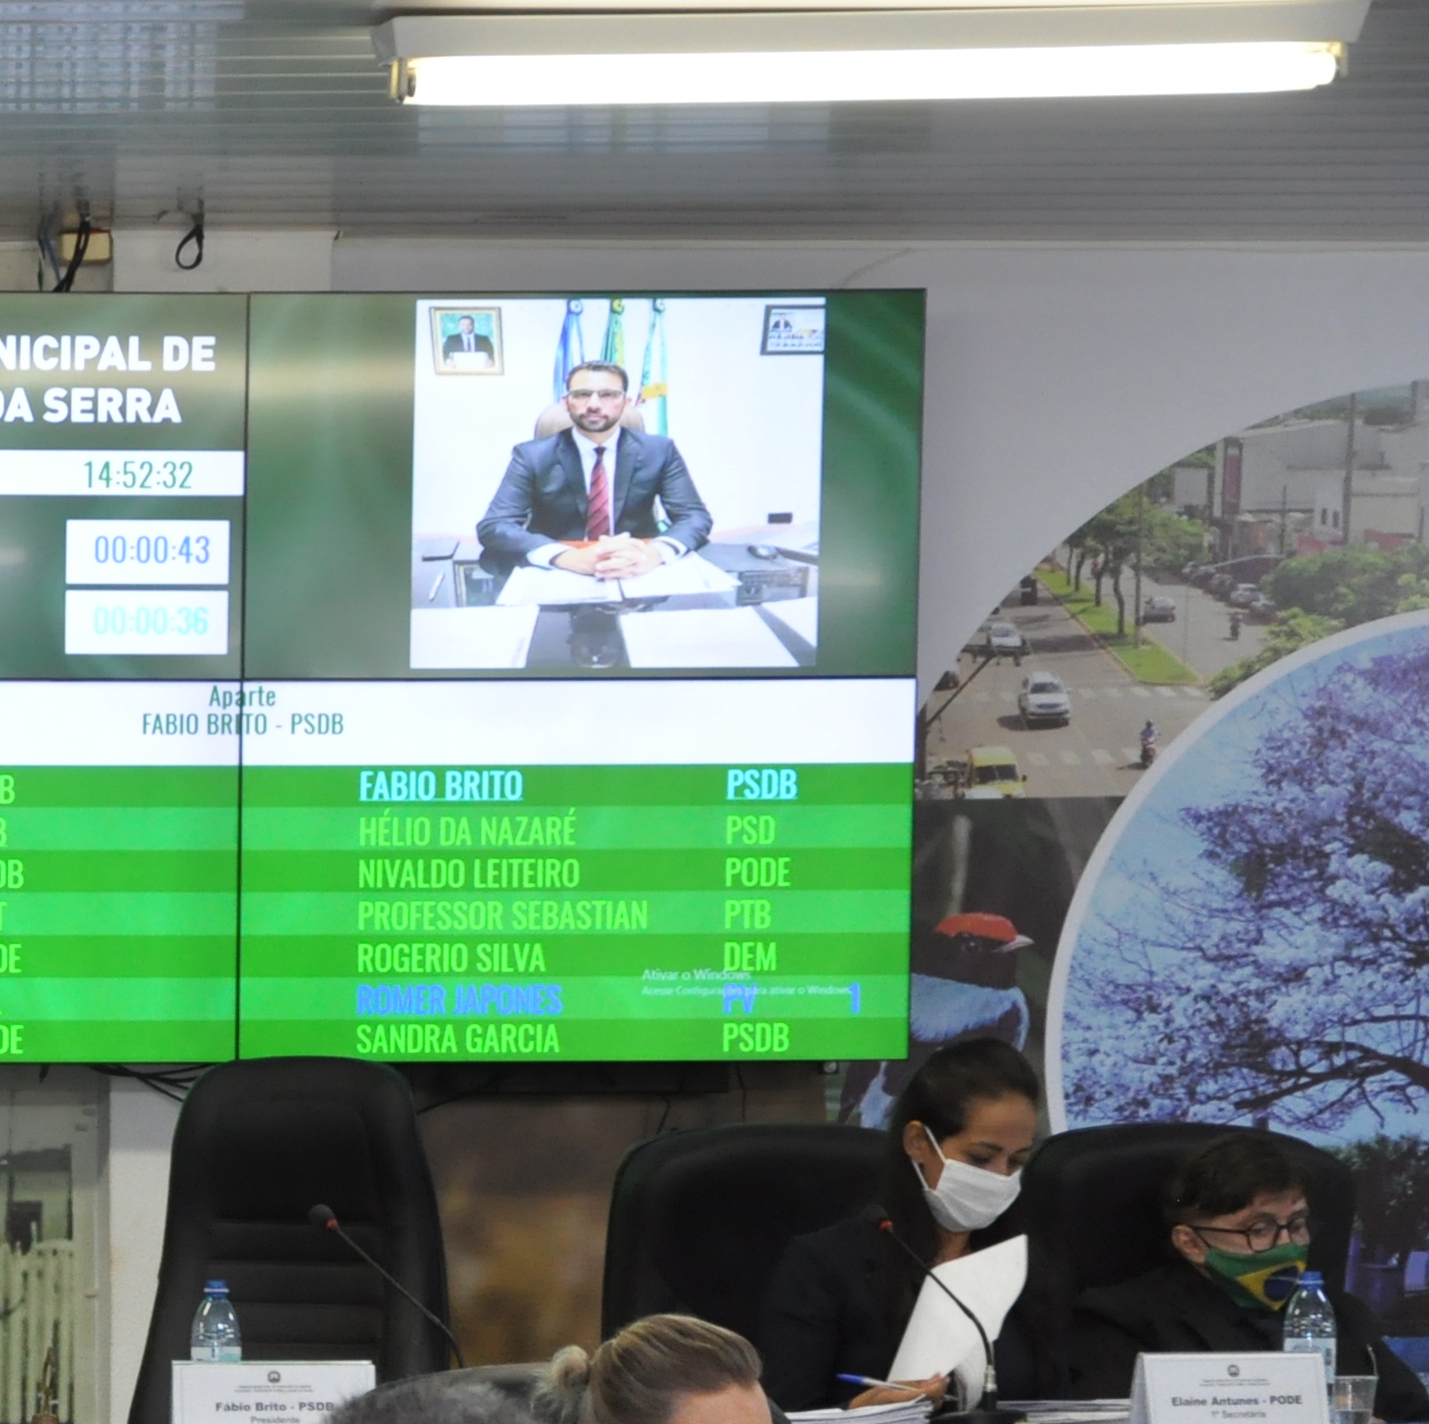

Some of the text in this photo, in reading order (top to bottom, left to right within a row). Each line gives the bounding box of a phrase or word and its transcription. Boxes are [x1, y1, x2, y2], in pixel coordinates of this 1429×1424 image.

[162, 336, 217, 373] DE
[42, 387, 183, 425] SERRA
[83, 460, 195, 490] 14:52:32
[94, 534, 211, 565] 00:00:43
[92, 605, 209, 636] 00:00:36
[209, 685, 277, 711] Aparte
[142, 713, 199, 736] FABIO
[206, 713, 267, 736] BRITO
[290, 713, 345, 736] PSDB
[359, 769, 525, 802] FABIO BRITO
[726, 768, 799, 800] PSDB
[358, 808, 577, 847] HÉLIO DA NAZARÉ
[725, 815, 777, 846] PSD
[358, 858, 580, 889] NIVALDO LEITEIRO
[725, 857, 792, 887] PODE
[358, 899, 649, 931] PROFESSOR SEBASTIAN
[724, 900, 772, 930] PTB
[357, 942, 547, 973] ROGERIO SILVA
[723, 942, 778, 972] DEM
[357, 984, 563, 1015] ROMER JAPONES
[723, 983, 757, 1014] PV
[847, 983, 861, 1014] 1
[356, 1023, 561, 1055] SANDRA GARCIA
[722, 1023, 791, 1053] PSDB
[215, 1401, 251, 1412] Fábio
[255, 1401, 287, 1412] Brito
[1171, 1396, 1208, 1407] Elaine
[1211, 1396, 1259, 1407] Antunes
[1269, 1395, 1303, 1406] PODE
[250, 1415, 301, 1424] Presidente
